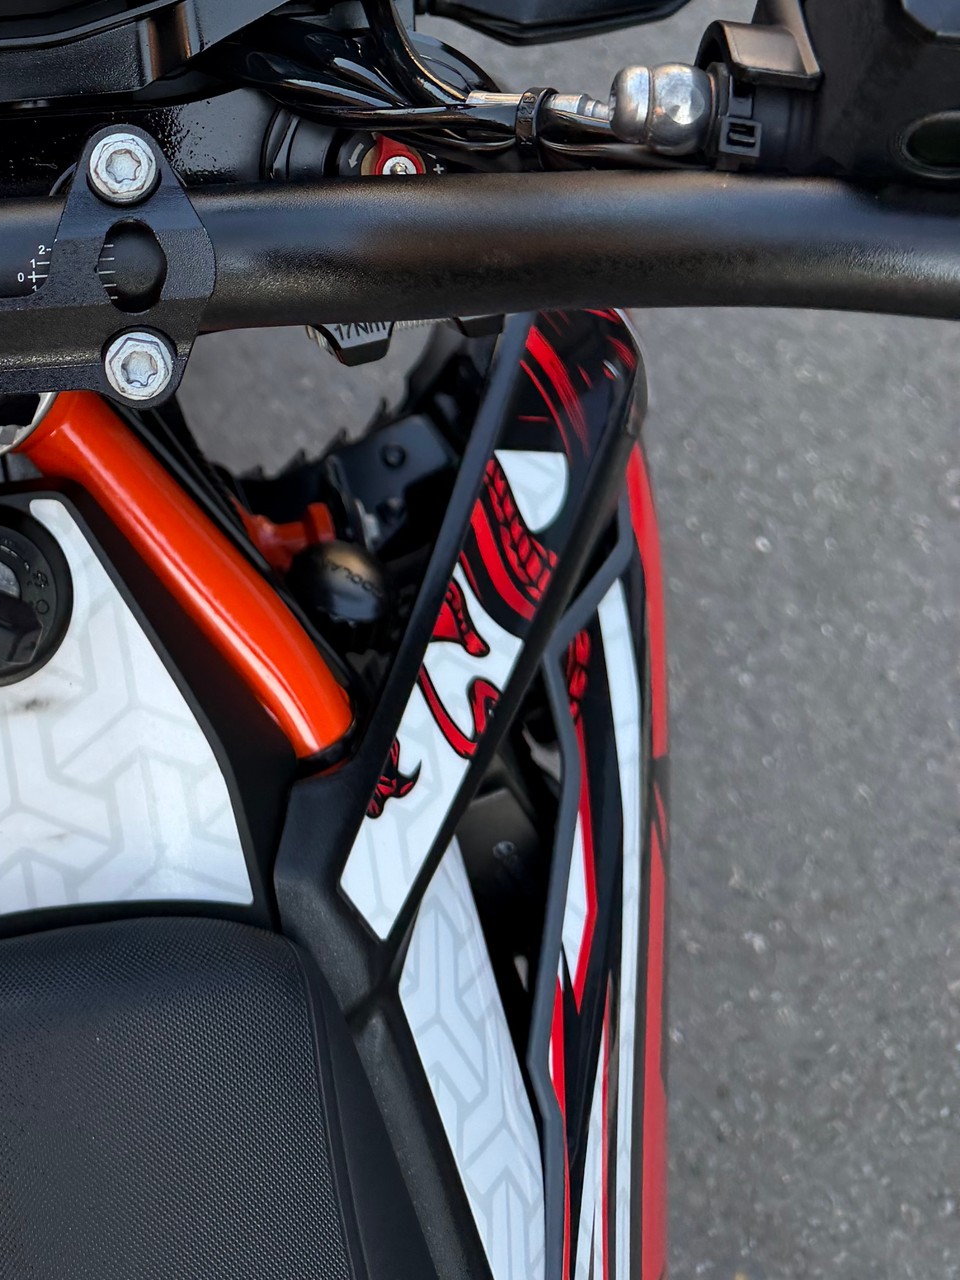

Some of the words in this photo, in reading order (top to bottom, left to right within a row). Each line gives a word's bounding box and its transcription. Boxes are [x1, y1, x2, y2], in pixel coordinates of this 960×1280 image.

[38, 244, 46, 255] 2
[29, 258, 36, 268] 1
[17, 272, 25, 283] 0
[334, 321, 387, 340] 17Nm
